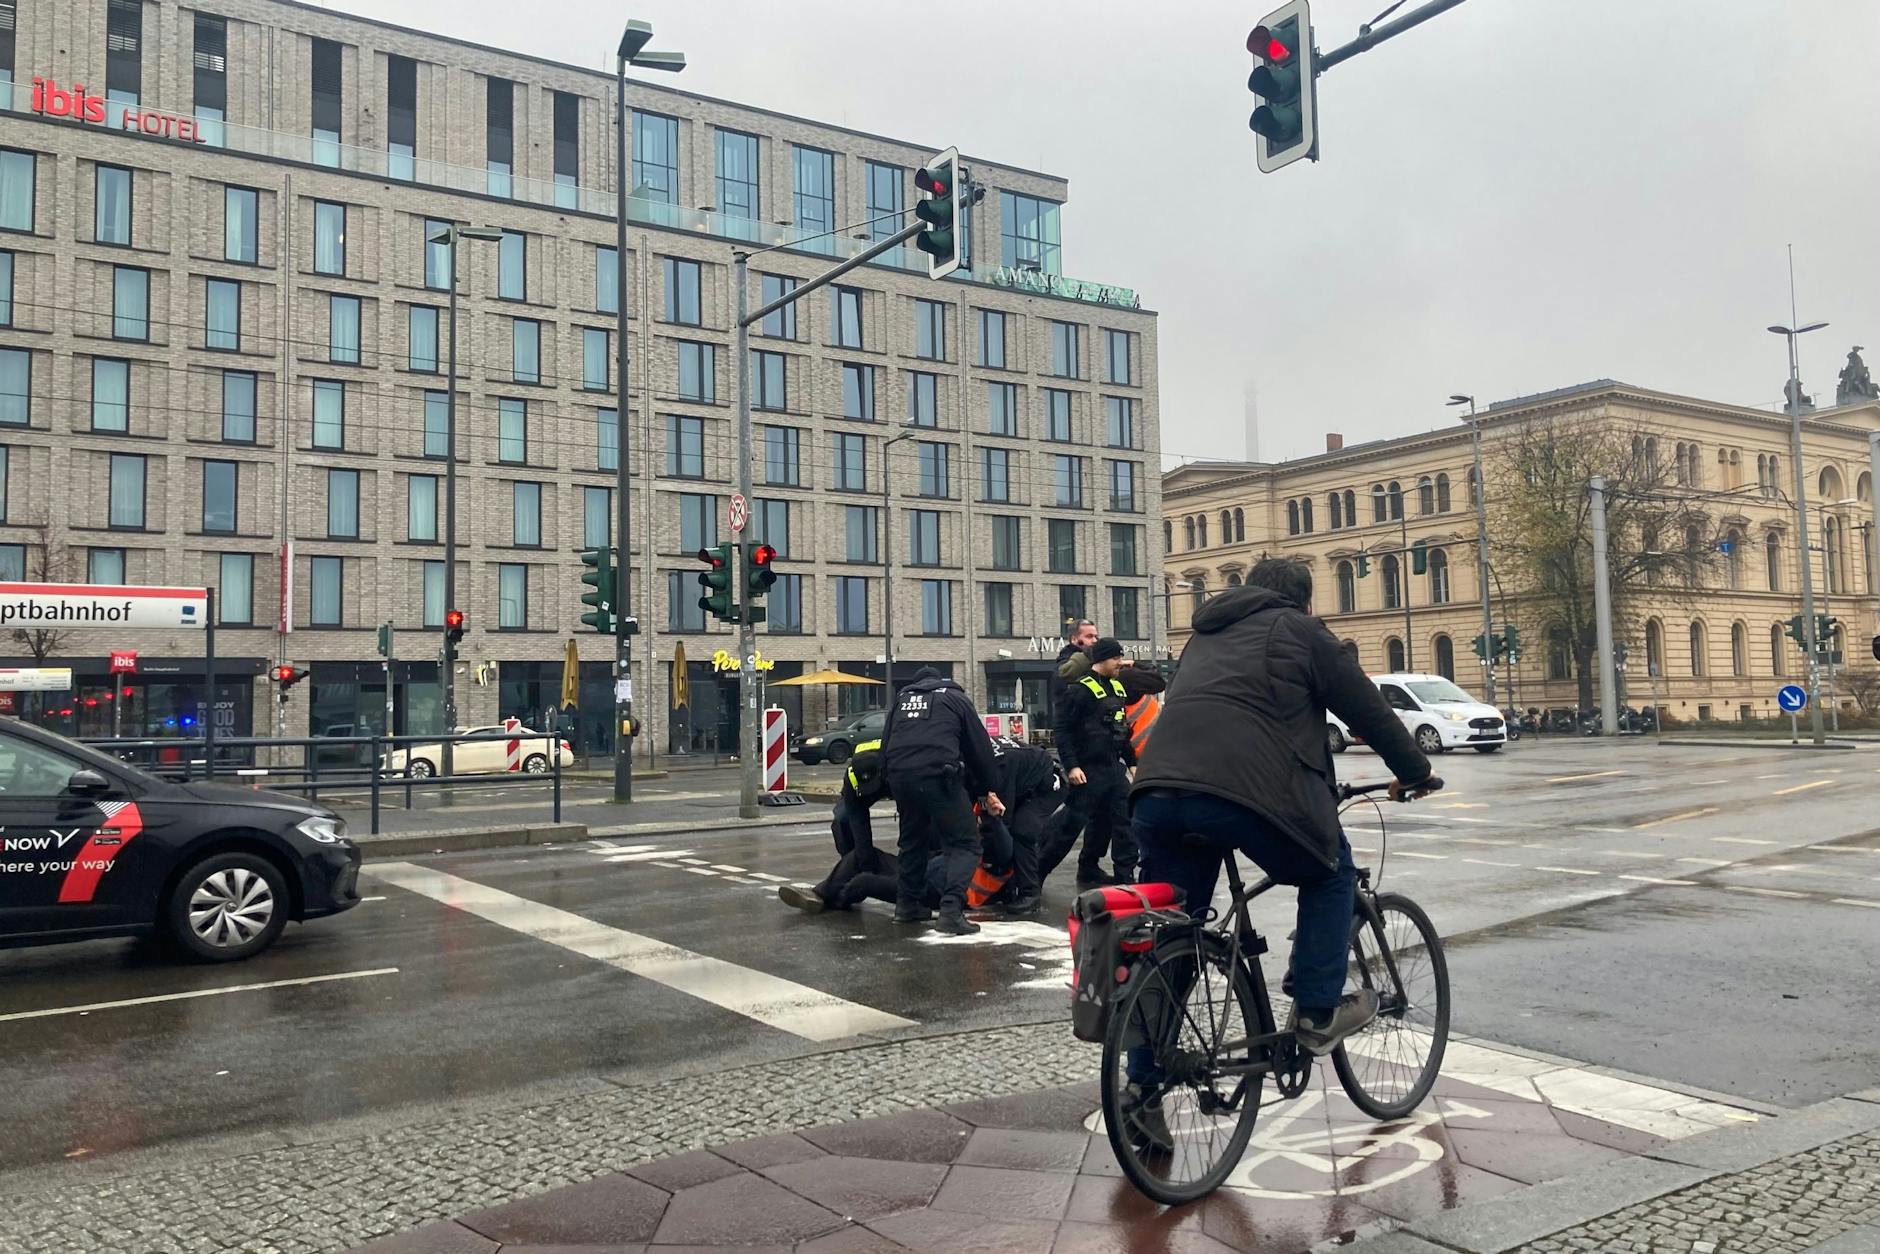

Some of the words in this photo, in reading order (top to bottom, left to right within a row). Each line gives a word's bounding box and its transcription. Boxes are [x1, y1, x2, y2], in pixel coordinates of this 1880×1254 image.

[32, 75, 105, 122] ibis
[123, 108, 206, 143] HOTEL
[995, 265, 1063, 289] AMANO
[1, 600, 132, 624] ptbahnhof
[1027, 636, 1066, 653] AMA
[1132, 645, 1173, 653] CENRAL
[114, 656, 135, 667] ibis
[711, 650, 741, 672] Pete
[901, 702, 928, 711] 22331
[197, 709, 234, 726] GOD
[39, 861, 77, 874] your
[82, 860, 115, 872] way
